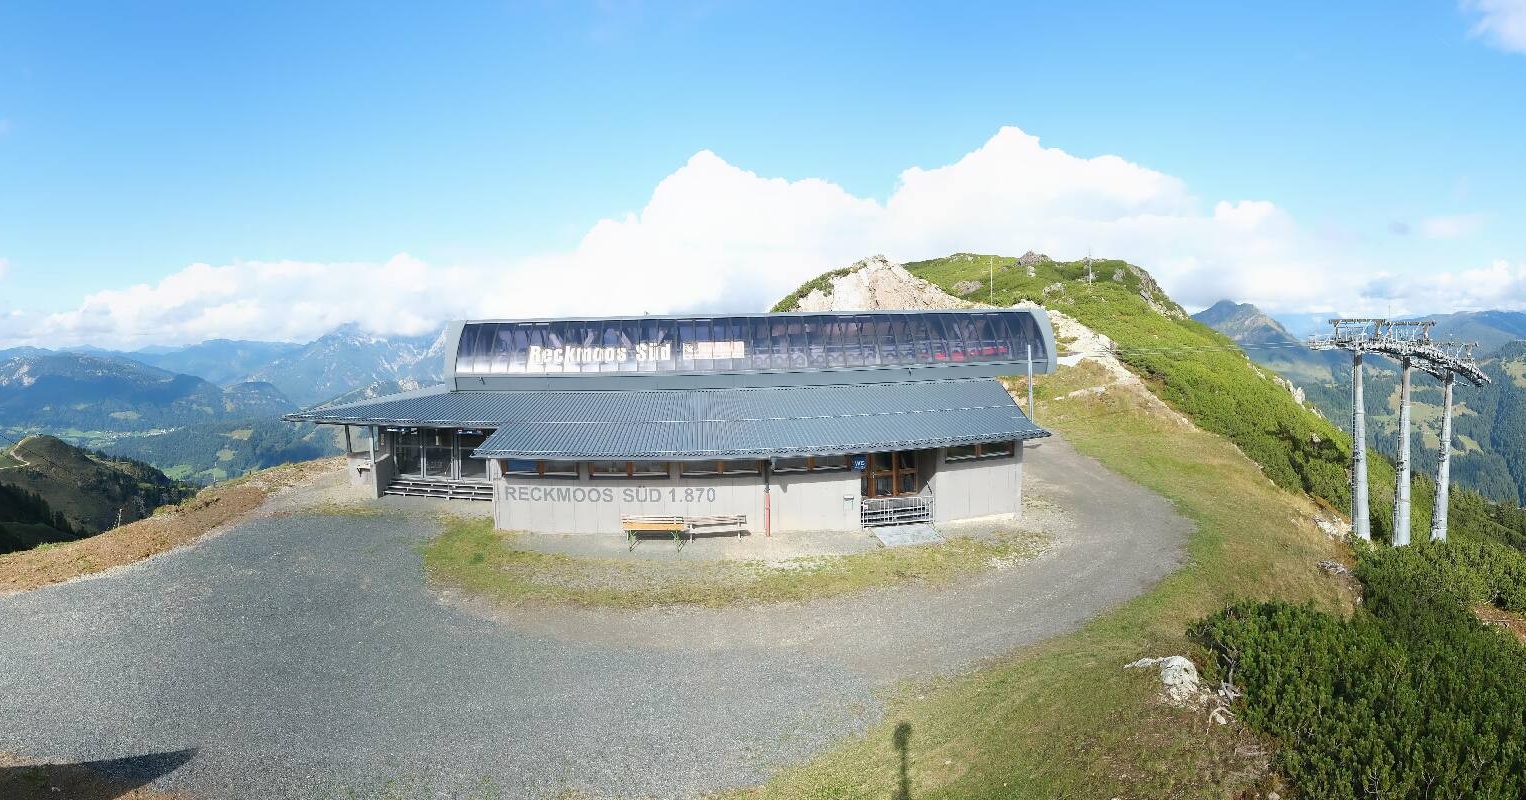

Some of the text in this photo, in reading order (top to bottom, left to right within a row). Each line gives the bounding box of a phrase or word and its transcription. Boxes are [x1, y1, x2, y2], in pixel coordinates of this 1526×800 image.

[527, 345, 627, 364] Reckmoos
[635, 342, 671, 361] Süd
[505, 485, 716, 503] RECKMOOS SÜD 1.870
